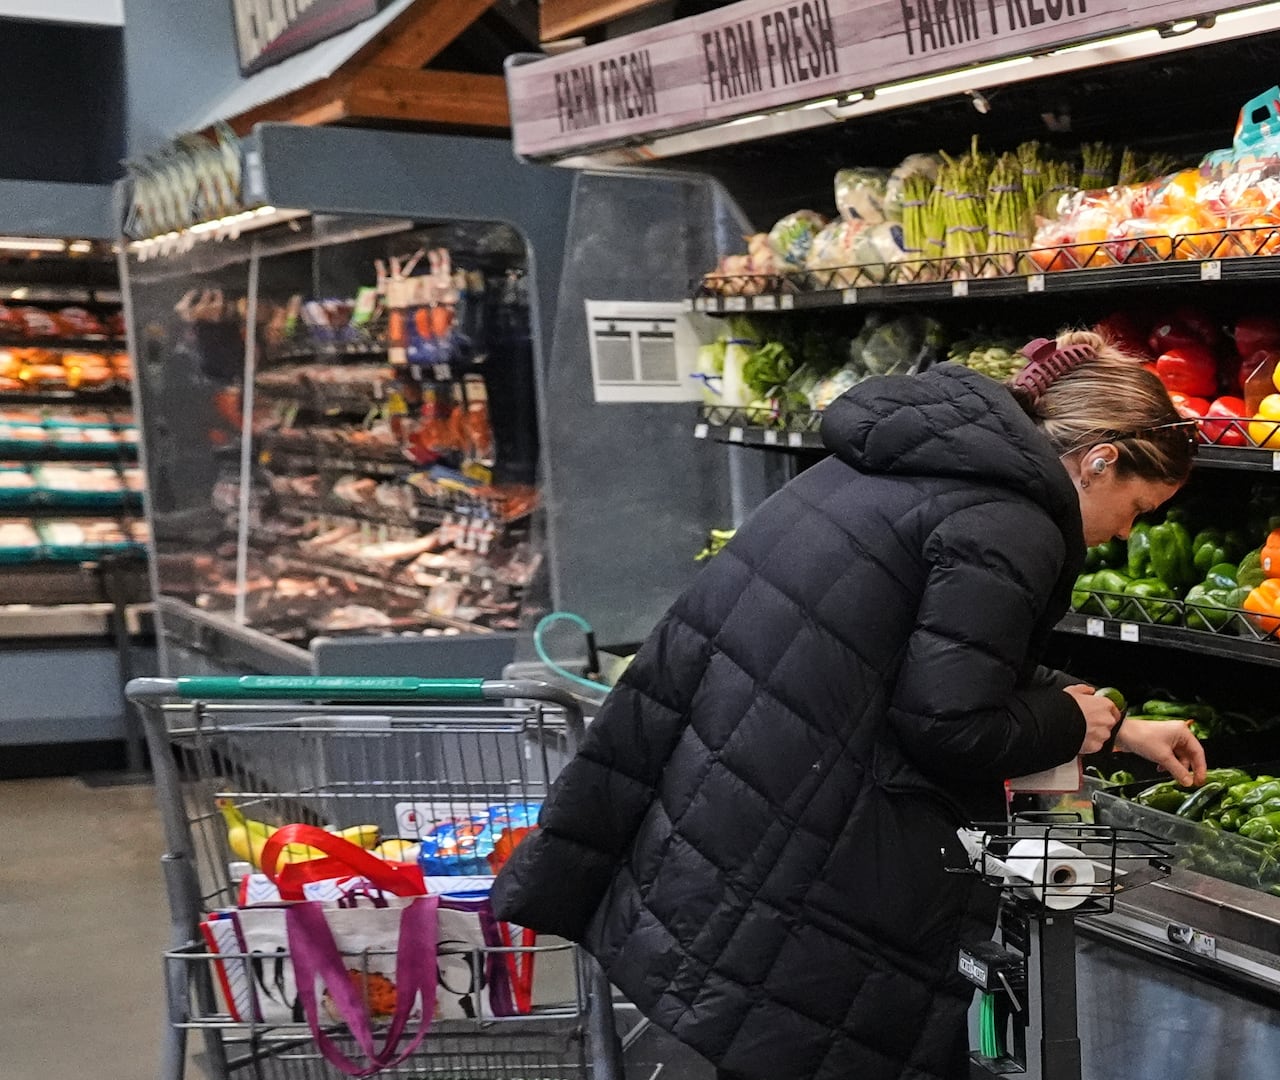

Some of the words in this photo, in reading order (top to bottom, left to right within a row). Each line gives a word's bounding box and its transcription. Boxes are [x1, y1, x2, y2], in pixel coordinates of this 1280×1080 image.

[555, 64, 598, 133] FARM
[600, 49, 657, 121] FRESH
[702, 25, 762, 102] FARM
[761, 0, 839, 88] FRESH
